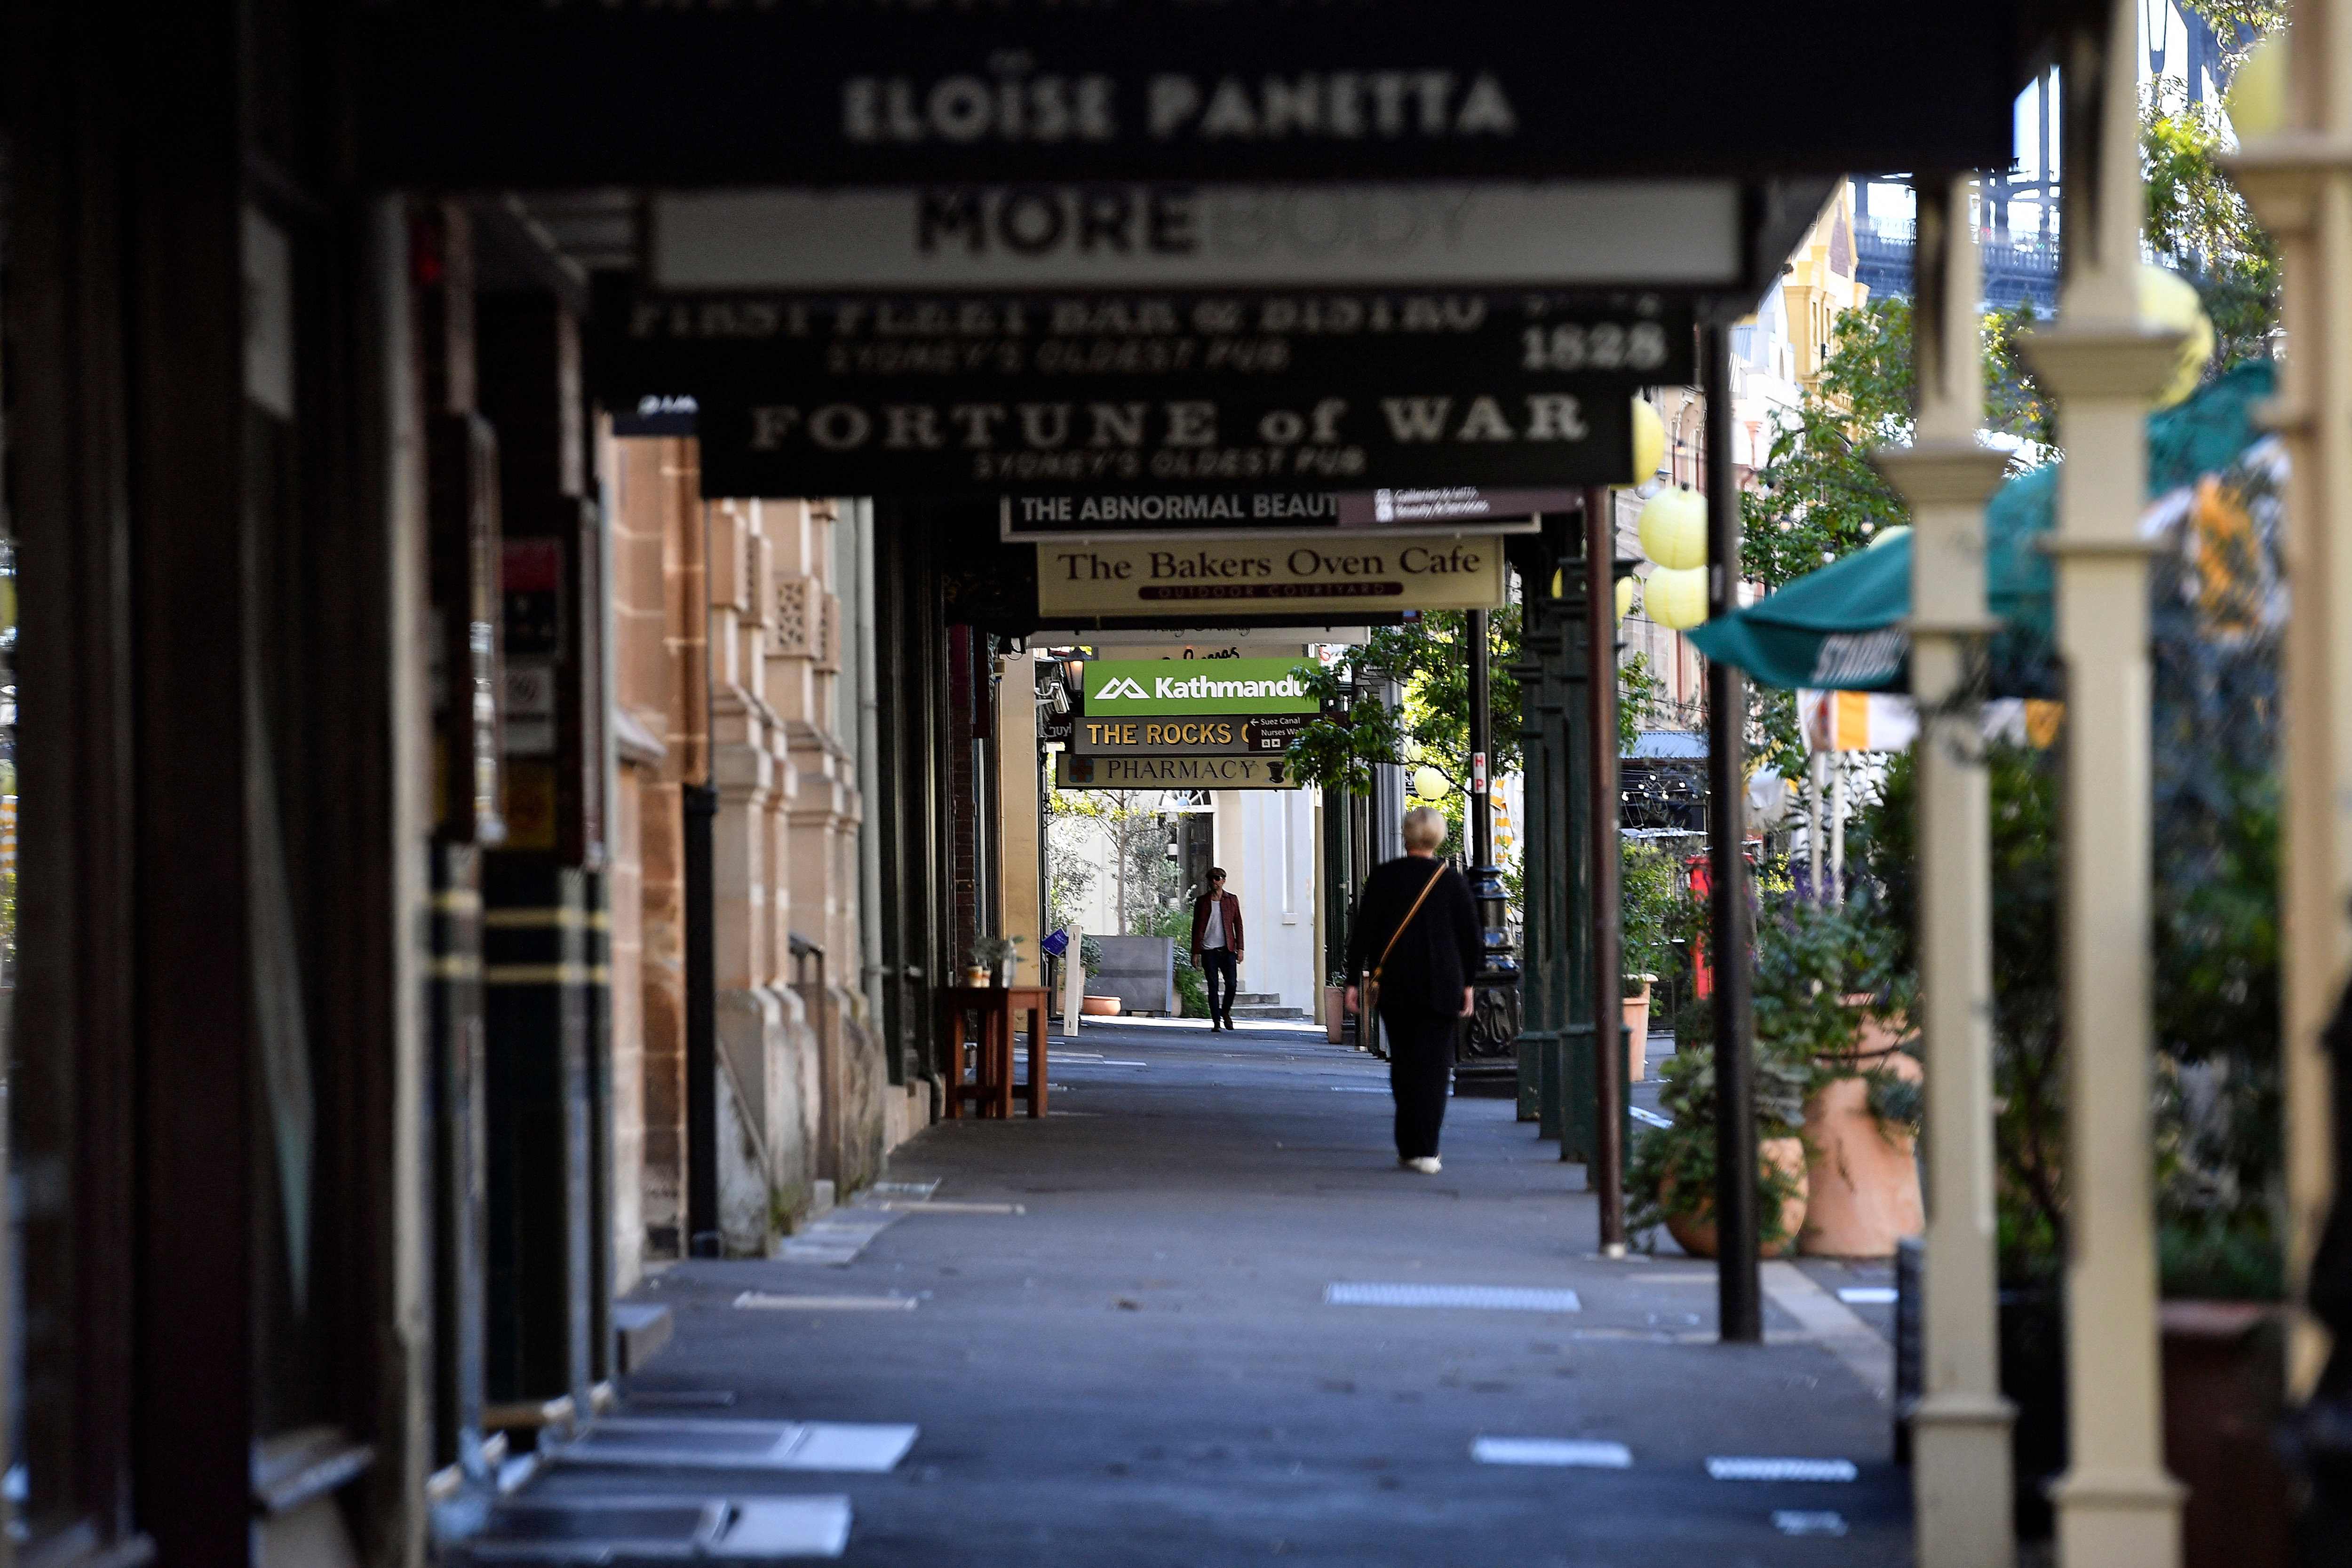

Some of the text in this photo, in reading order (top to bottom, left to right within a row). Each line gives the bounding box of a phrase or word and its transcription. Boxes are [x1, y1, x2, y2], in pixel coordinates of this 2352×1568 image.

[1144, 70, 1517, 141] PANETTA
[1035, 337, 1195, 375] OLDEST
[1205, 335, 1292, 373] PUB
[1522, 322, 1666, 371] 1828
[747, 398, 1220, 451] FORTUNE
[1259, 394, 1348, 444] of
[1378, 392, 1589, 442] WAR
[1148, 448, 1285, 478] OLDEST
[1293, 446, 1368, 476] PUB
[1020, 496, 1072, 520] THE
[1079, 494, 1245, 519] ABNORMAL
[1057, 545, 1480, 580] The Bakers Oven Cafe
[1158, 584, 1385, 598] OUTDOOR COURTYARD
[1155, 674, 1311, 699] Kathmandu
[1087, 724, 1137, 744] THE
[1147, 723, 1232, 744] ROCKS
[1279, 716, 1301, 725] Canal
[1107, 760, 1253, 779] PHARMACY
